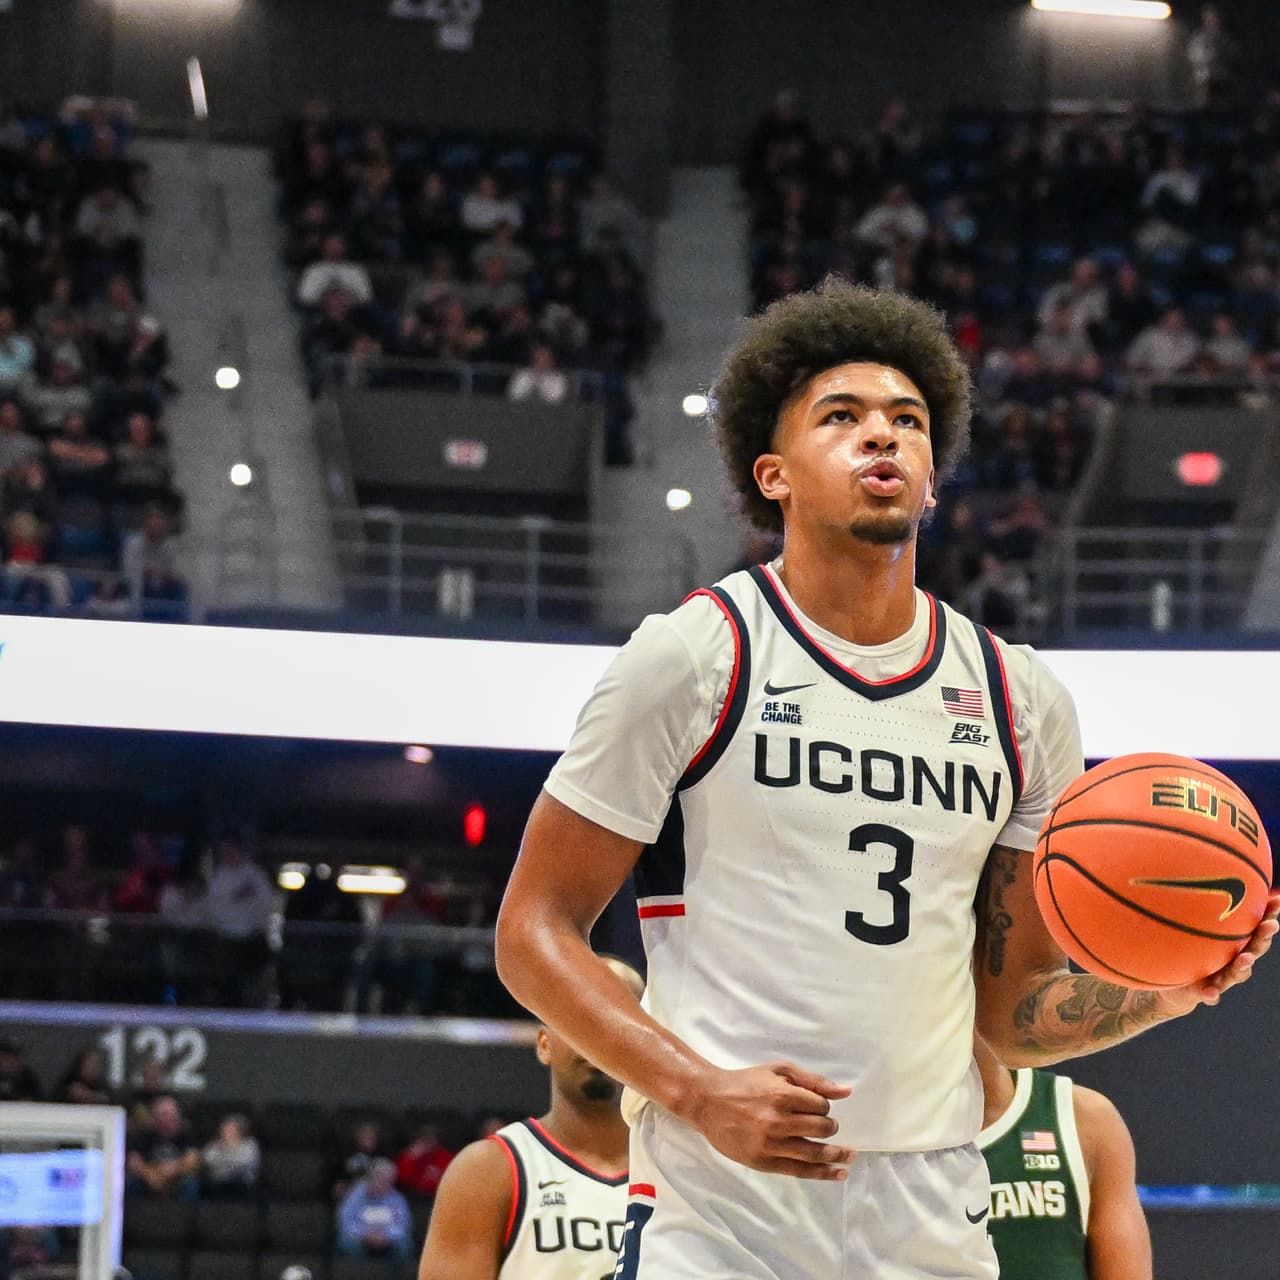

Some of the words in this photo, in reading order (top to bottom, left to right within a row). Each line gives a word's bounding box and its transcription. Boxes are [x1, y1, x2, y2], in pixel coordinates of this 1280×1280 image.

[761, 711, 803, 725] CHANGE
[765, 702, 779, 711] BE
[783, 702, 801, 713] THE
[951, 731, 991, 743] EAST
[954, 723, 982, 733] BIG
[755, 733, 1001, 822] UCONN
[1151, 783, 1259, 848] ELITE
[845, 823, 914, 946] 3
[99, 1025, 208, 1090] 122
